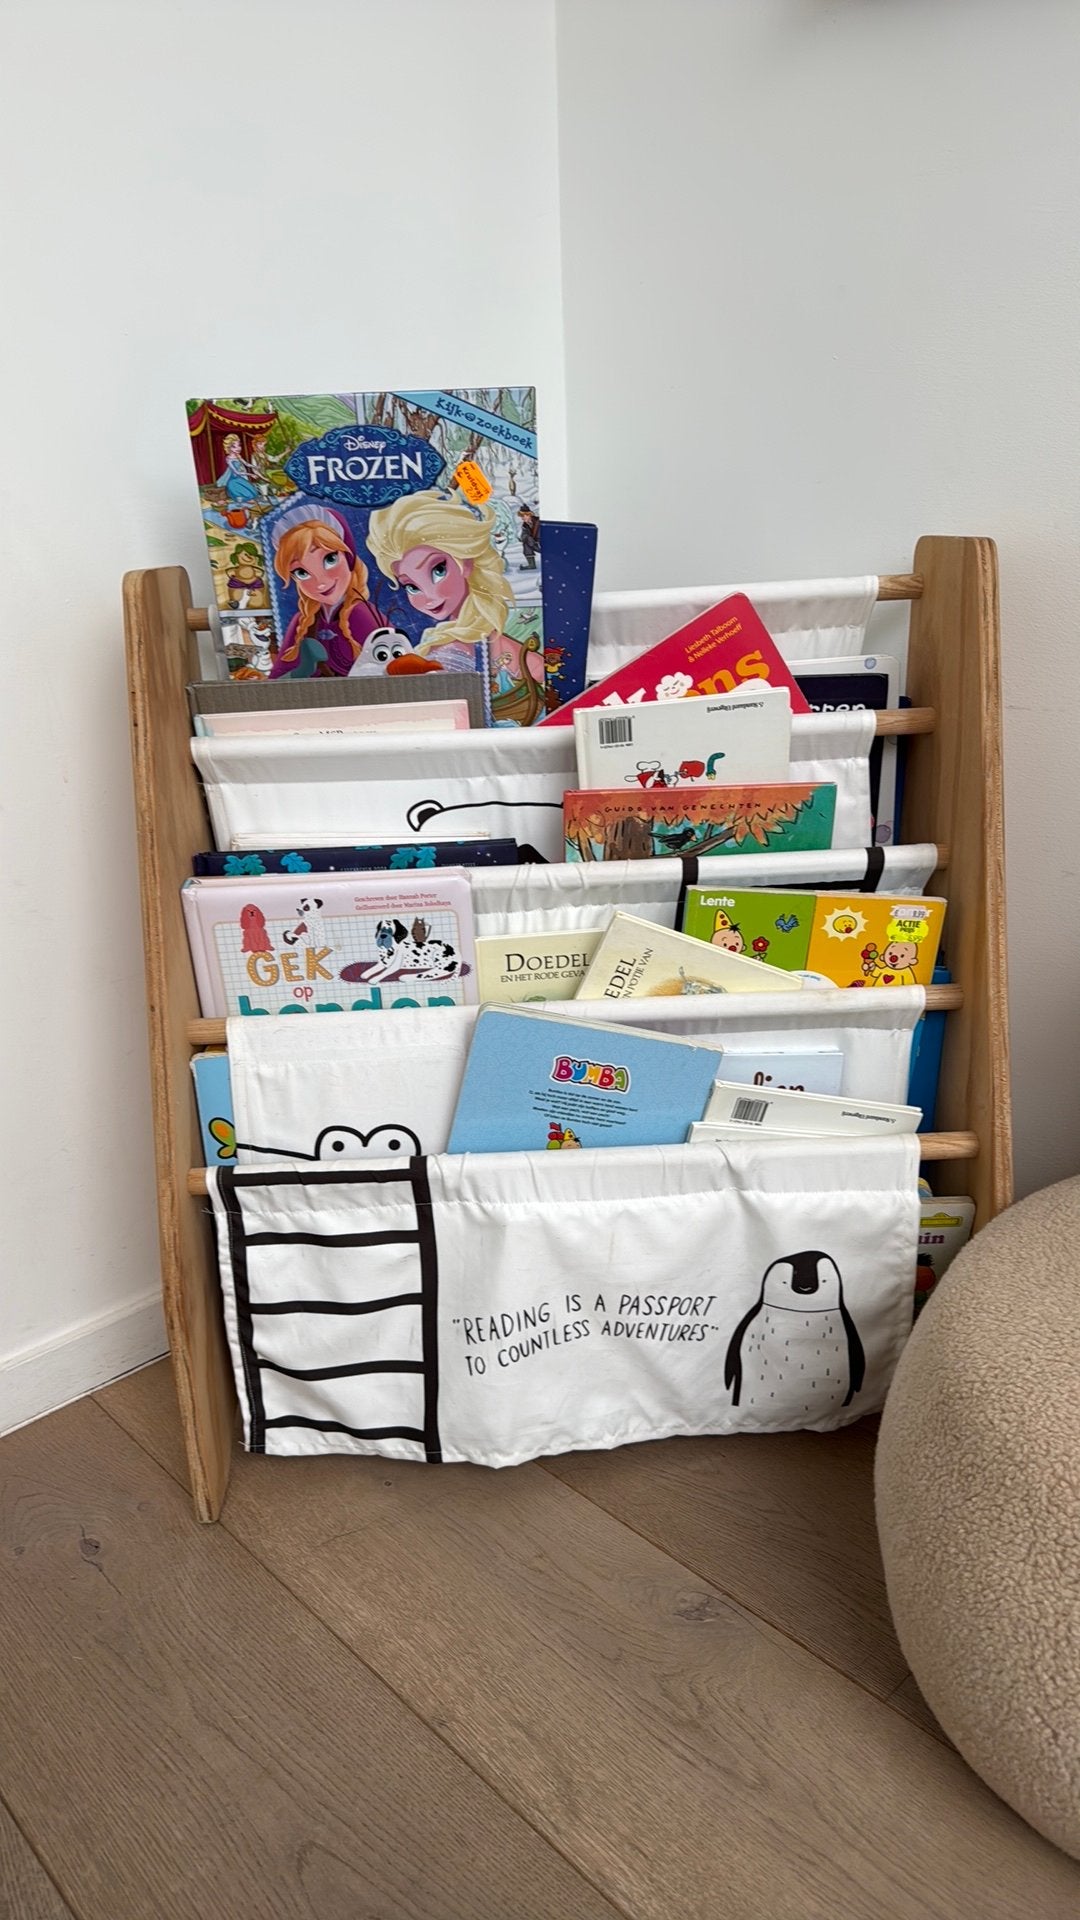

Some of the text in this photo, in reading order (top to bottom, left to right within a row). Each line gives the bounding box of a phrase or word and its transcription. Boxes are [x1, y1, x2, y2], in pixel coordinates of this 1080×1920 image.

[340, 435, 387, 453] Disney
[306, 451, 423, 485] FROZEN
[685, 616, 738, 654] Liesbeth Talboom
[715, 624, 743, 644] Verhoeff
[682, 803, 761, 811] GENECHTEN
[700, 895, 736, 907] Lente
[896, 919, 921, 928] ACTIE
[246, 947, 334, 987] GEK
[638, 948, 654, 968] VAN
[500, 975, 513, 983] EN
[515, 973, 535, 982] HET
[534, 971, 559, 980] RODE
[292, 986, 314, 1001] op
[551, 1056, 629, 1092] BUMBA
[566, 1294, 582, 1313] IS
[594, 1293, 606, 1312] A
[618, 1294, 718, 1316] PASSPORT
[465, 1355, 486, 1376] TO
[497, 1319, 591, 1367] COUNTLESS
